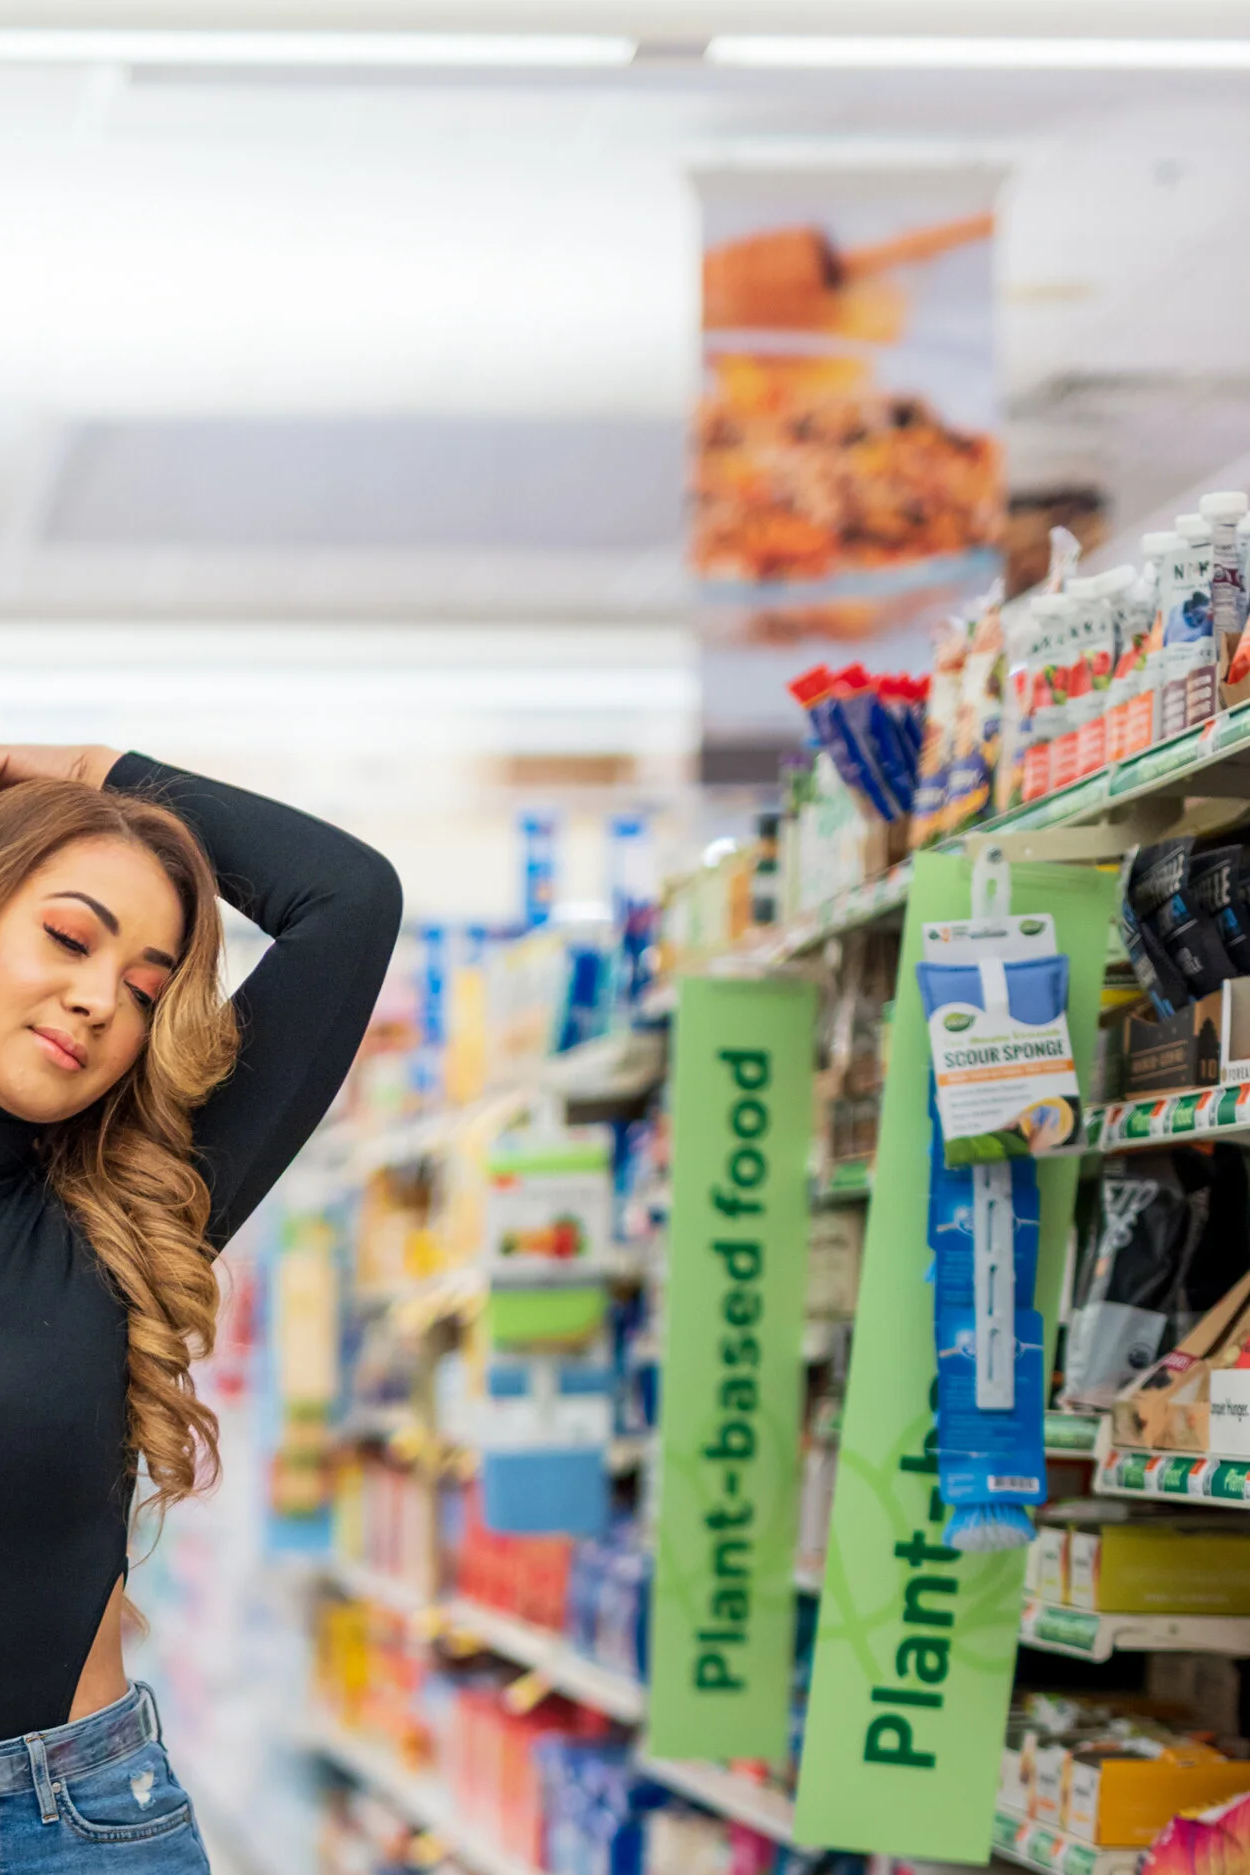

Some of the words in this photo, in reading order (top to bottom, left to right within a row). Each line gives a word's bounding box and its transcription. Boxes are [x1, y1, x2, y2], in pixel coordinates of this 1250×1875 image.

[710, 1048, 770, 1221] food
[944, 1046, 1000, 1068] SCOUR
[1003, 1038, 1065, 1061] SPONGE
[693, 1238, 766, 1693] Plant-based
[863, 1374, 962, 1769] Plant-b
